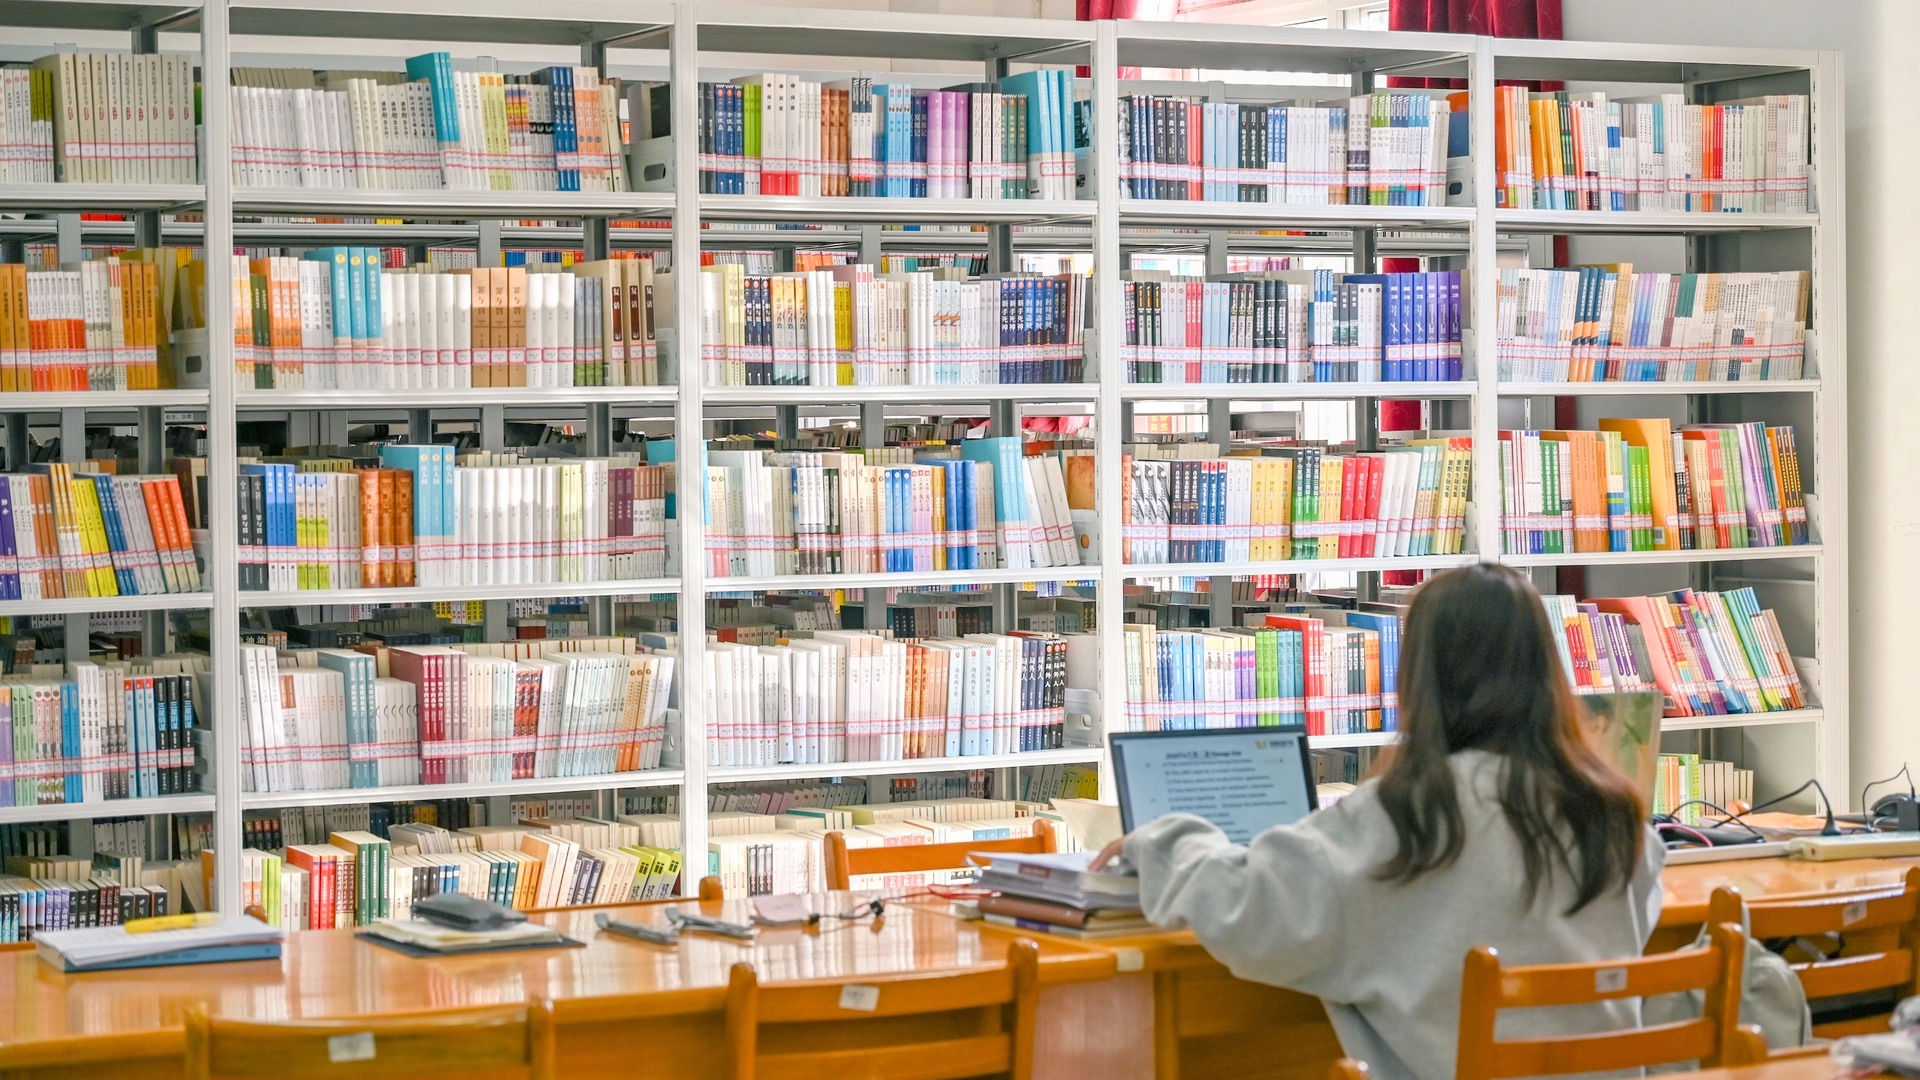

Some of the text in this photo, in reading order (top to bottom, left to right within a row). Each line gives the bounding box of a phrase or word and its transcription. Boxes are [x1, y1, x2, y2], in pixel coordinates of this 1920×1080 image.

[1157, 119, 1164, 135] 教父
[1168, 119, 1175, 135] 教父
[1179, 120, 1186, 135] 教父
[613, 287, 621, 310] 复活
[630, 286, 638, 309] 复活
[646, 287, 653, 309] 复活
[1357, 473, 1365, 500] 爱尔兰人
[1370, 472, 1379, 500] 爱尔兰人
[1444, 459, 1454, 498] 爱默生随笔集
[1453, 459, 1462, 498] 爱默生随笔集
[1461, 459, 1470, 498] 爱默生随笔集
